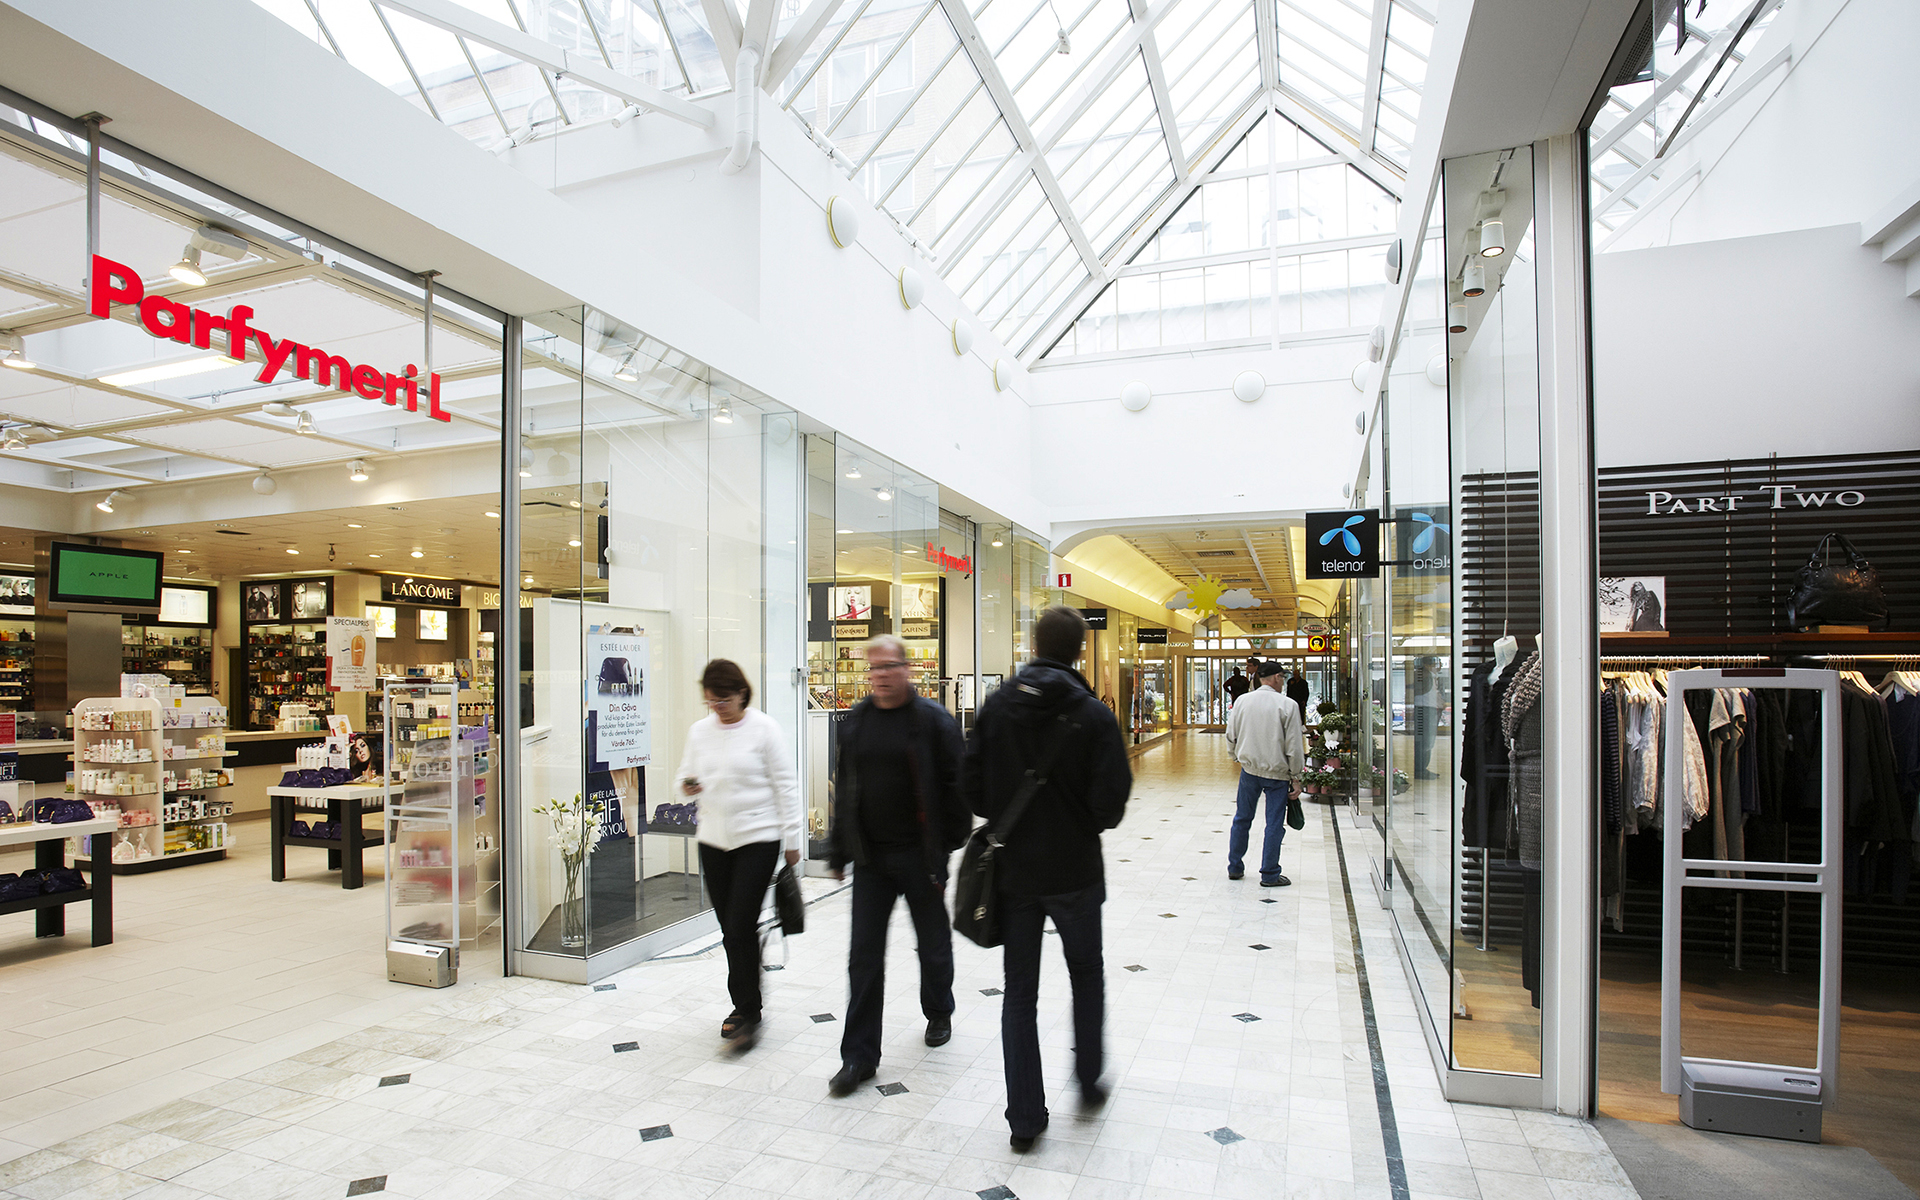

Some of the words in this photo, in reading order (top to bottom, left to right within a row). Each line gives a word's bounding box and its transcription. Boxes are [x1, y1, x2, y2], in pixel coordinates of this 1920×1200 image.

[87, 254, 417, 412] Parfymeri
[426, 372, 451, 423] L
[1645, 490, 1743, 516] PART
[1759, 484, 1866, 510] TWO
[926, 541, 967, 573] Parfymeri
[1321, 559, 1366, 573] telenor
[89, 571, 129, 580] APPLE
[391, 582, 455, 601] LANCÔME
[334, 618, 370, 627] SPECIALPRIS
[600, 643, 618, 652] ESTÉE
[619, 644, 641, 652] LAUDER
[609, 703, 620, 712] Din
[0, 764, 17, 775] IFT
[608, 821, 627, 836] YOU
